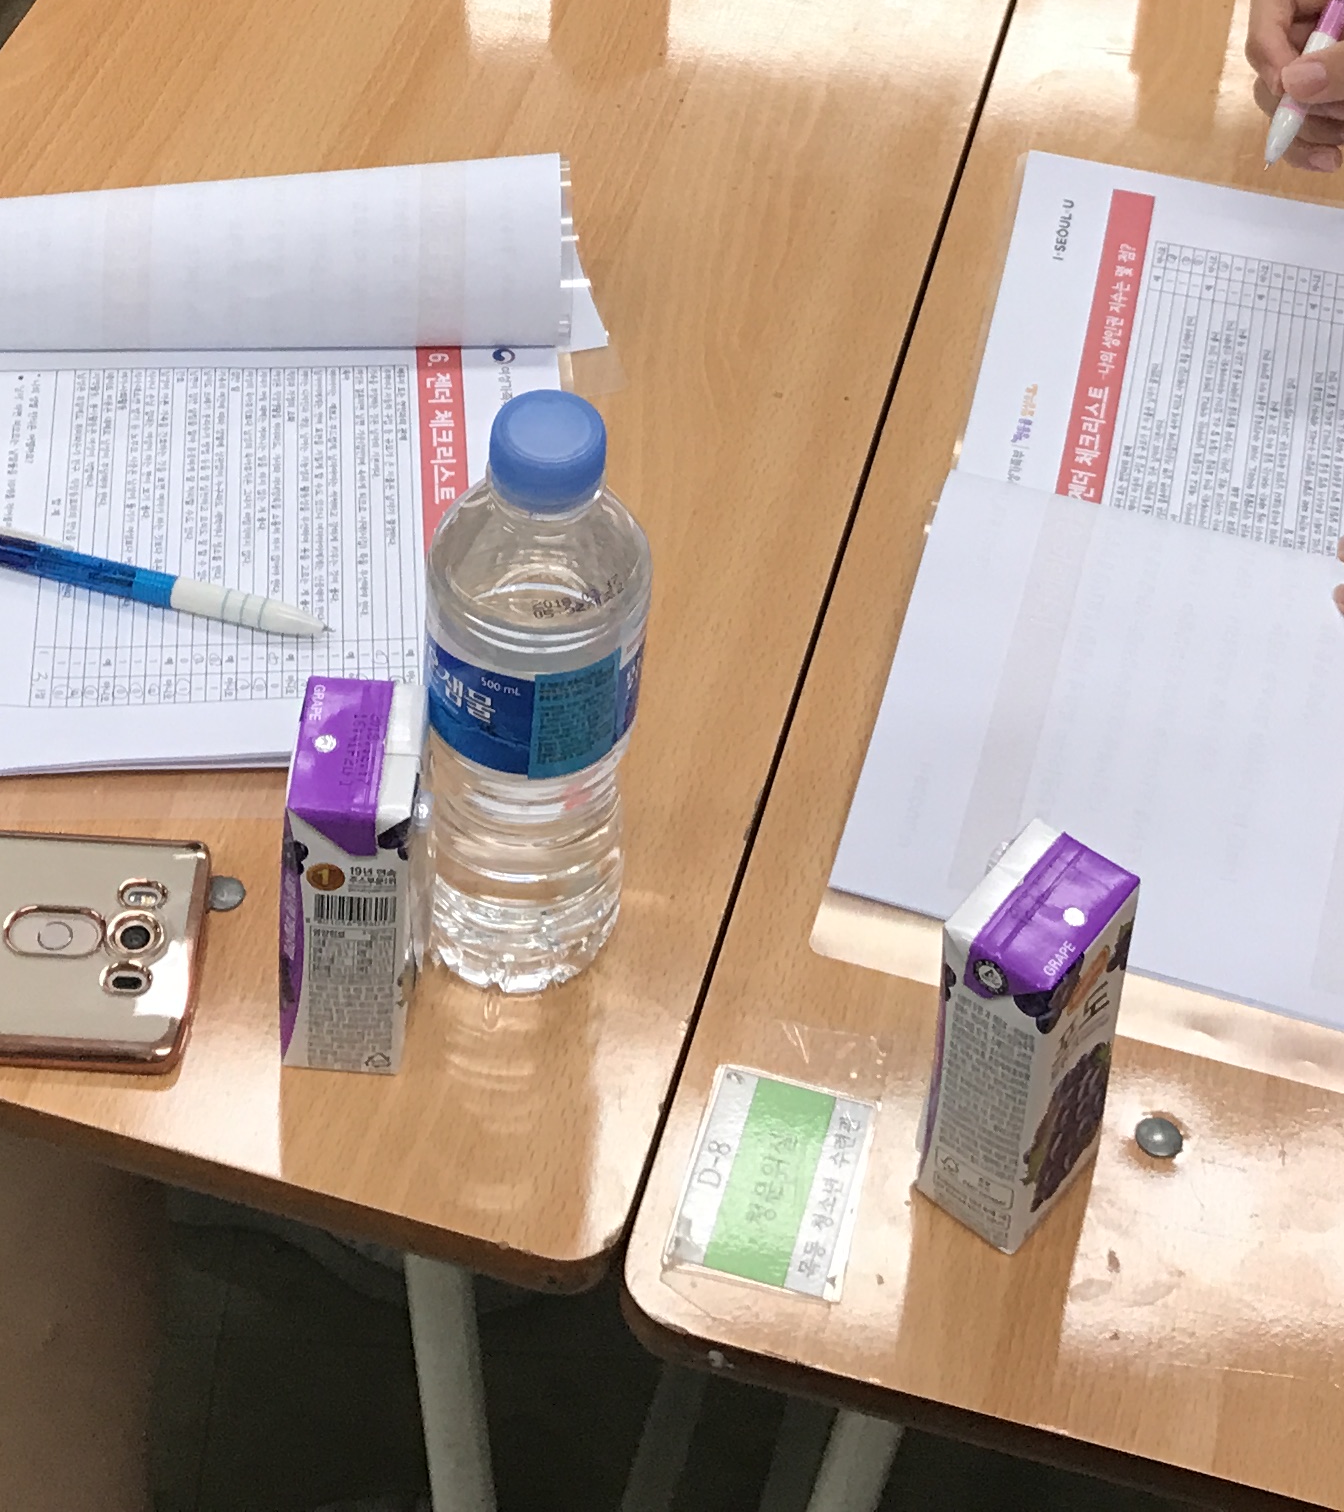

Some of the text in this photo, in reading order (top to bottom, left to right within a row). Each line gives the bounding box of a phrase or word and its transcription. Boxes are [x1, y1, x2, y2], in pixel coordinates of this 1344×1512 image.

[1117, 242, 1139, 265] 점?
[1109, 279, 1132, 314] 지수는
[1104, 314, 1125, 349] 성인권
[496, 366, 515, 404] 여성가족
[424, 352, 462, 504] 6. 젠더 체크리스트
[1072, 382, 1112, 468] 체크리스트
[308, 684, 327, 721] GRAPE
[480, 675, 522, 697] 500 mL
[349, 865, 373, 876] 19년
[1042, 939, 1076, 978] GRAPE
[695, 1137, 732, 1188] D-8
[796, 1111, 862, 1280] 목동 청소년 수련관
